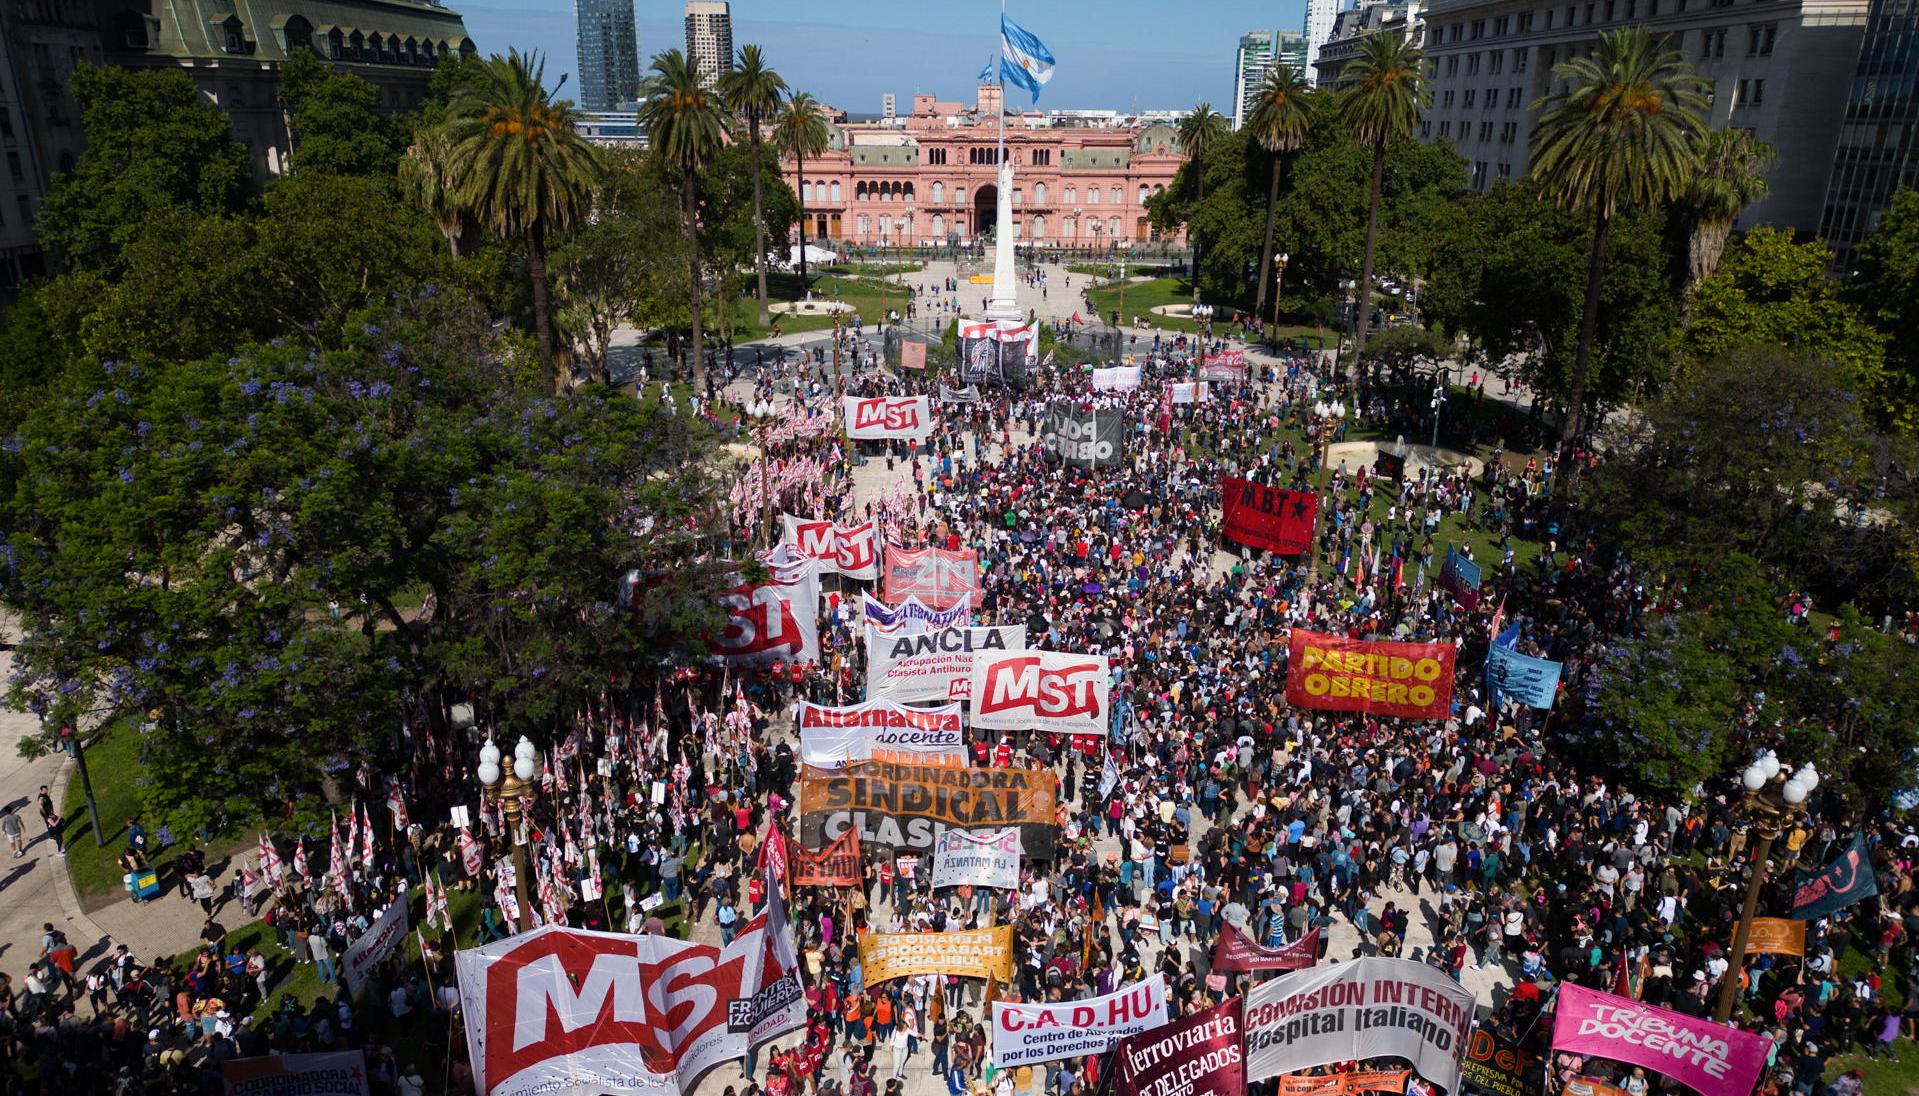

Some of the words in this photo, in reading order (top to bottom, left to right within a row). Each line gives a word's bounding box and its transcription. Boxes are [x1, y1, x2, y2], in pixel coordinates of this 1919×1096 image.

[860, 402, 917, 428] MST
[803, 525, 873, 567] MST
[890, 627, 1006, 659] ANCLA
[1303, 646, 1441, 681] PARTIDO
[991, 662, 1097, 713] MST
[1304, 673, 1435, 706] OBRERO
[802, 706, 960, 731] Alternativa
[876, 727, 960, 744] docente
[828, 778, 1027, 823] SINDICAL
[513, 930, 768, 1054] MST
[1244, 977, 1365, 1032] COMISIÓN
[1374, 979, 1467, 1038] INTERN
[1023, 1032, 1065, 1045] Centro
[1072, 1028, 1082, 1039] de
[1126, 1013, 1237, 1077] ferroviaria
[1247, 1009, 1345, 1052] Hospital
[1355, 1006, 1450, 1051] Italiano
[1590, 1003, 1729, 1060] TRIBUNA
[1002, 1050, 1023, 1063] por
[1026, 1047, 1043, 1058] los
[1047, 1038, 1104, 1054] Derechos
[1578, 1018, 1731, 1080] DOCENTE
[233, 1068, 349, 1095] COORDINADORA
[628, 1077, 644, 1087] de
[649, 1076, 666, 1088] los
[1155, 1044, 1241, 1096] DELEGADOS
